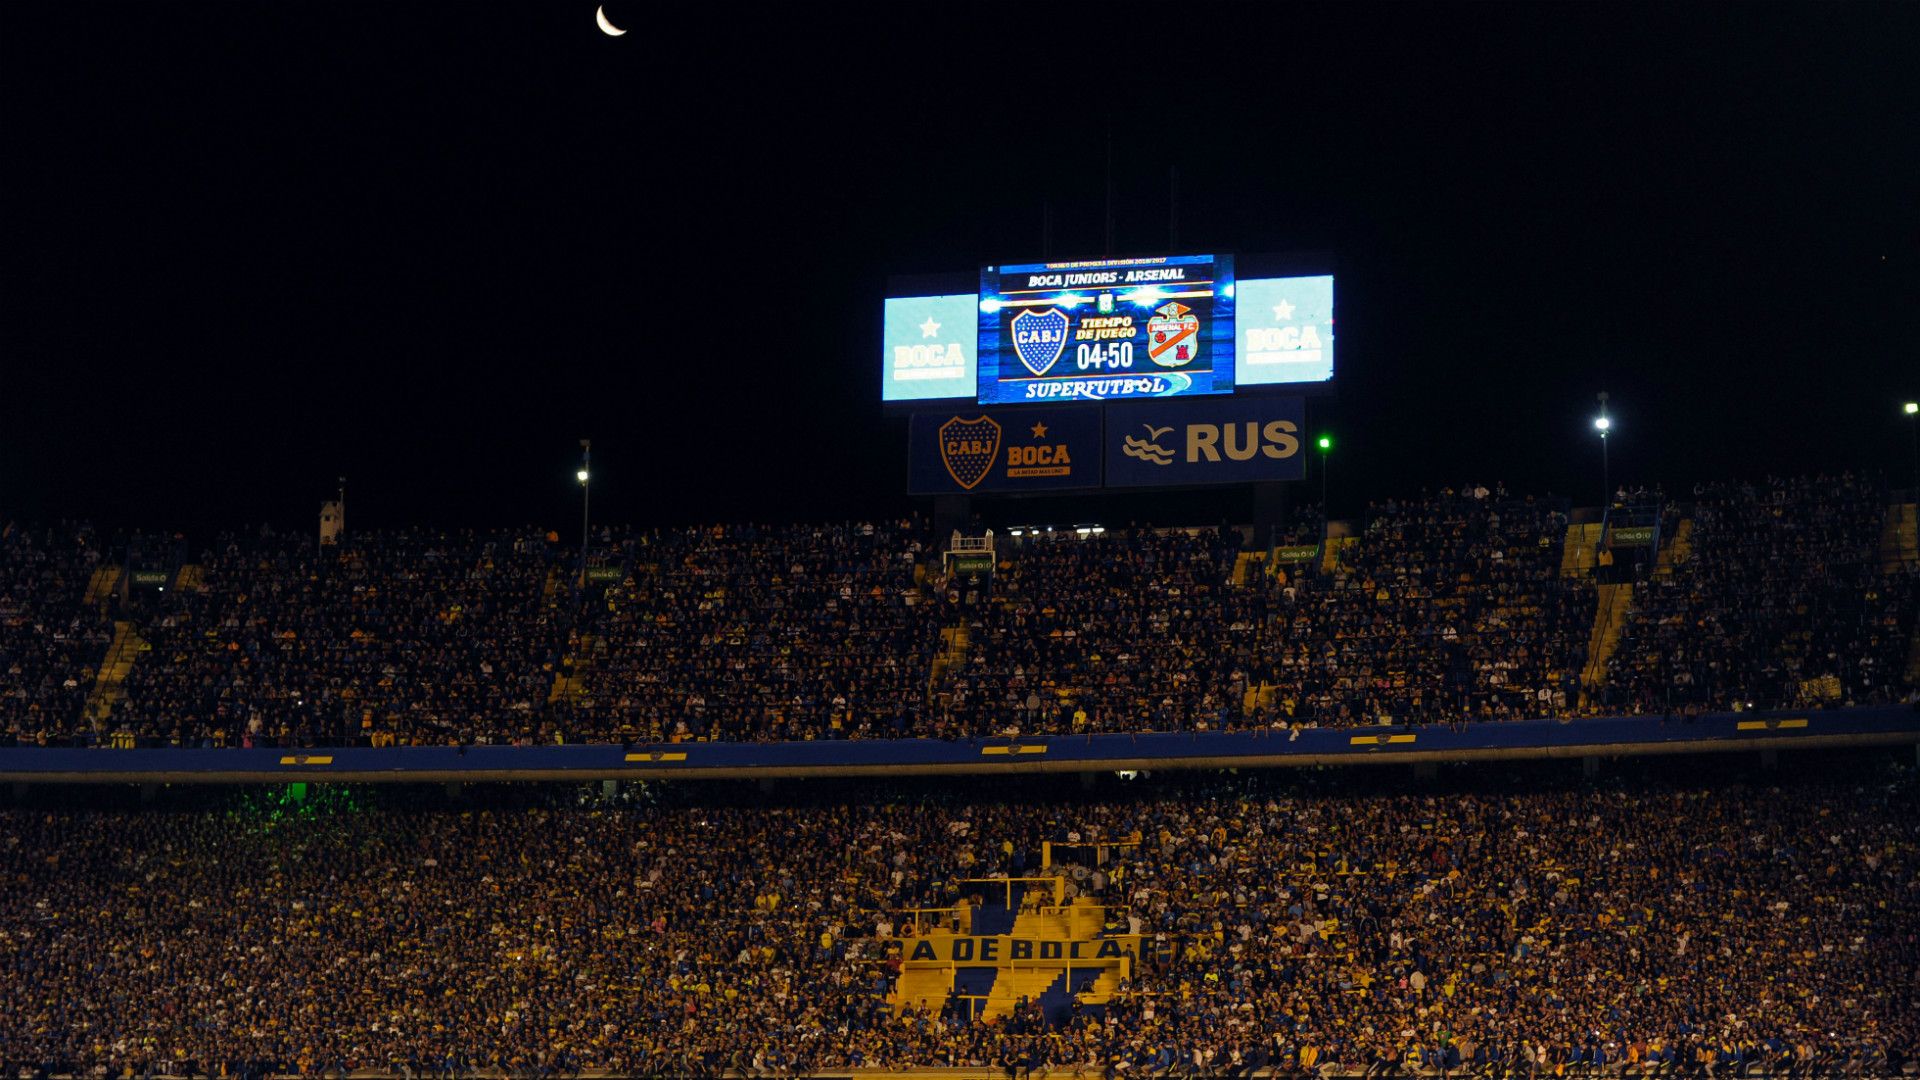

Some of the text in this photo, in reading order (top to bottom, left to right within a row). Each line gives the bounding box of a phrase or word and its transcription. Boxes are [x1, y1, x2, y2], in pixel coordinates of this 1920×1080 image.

[1029, 274, 1062, 287] BOCA
[1063, 271, 1117, 287] JUNIORS
[1125, 268, 1185, 282] ARSENAL
[1081, 316, 1132, 329] TIEMPO
[1018, 330, 1061, 343] CABJ
[1075, 327, 1137, 341] DE JUEGO
[1246, 325, 1322, 351] BOCA
[894, 343, 965, 368] BOCA
[1077, 341, 1133, 370] 04:50
[947, 440, 992, 455] CABJ
[1187, 420, 1299, 463] RUS
[1007, 444, 1070, 466] BOCA
[952, 938, 998, 960] DE
